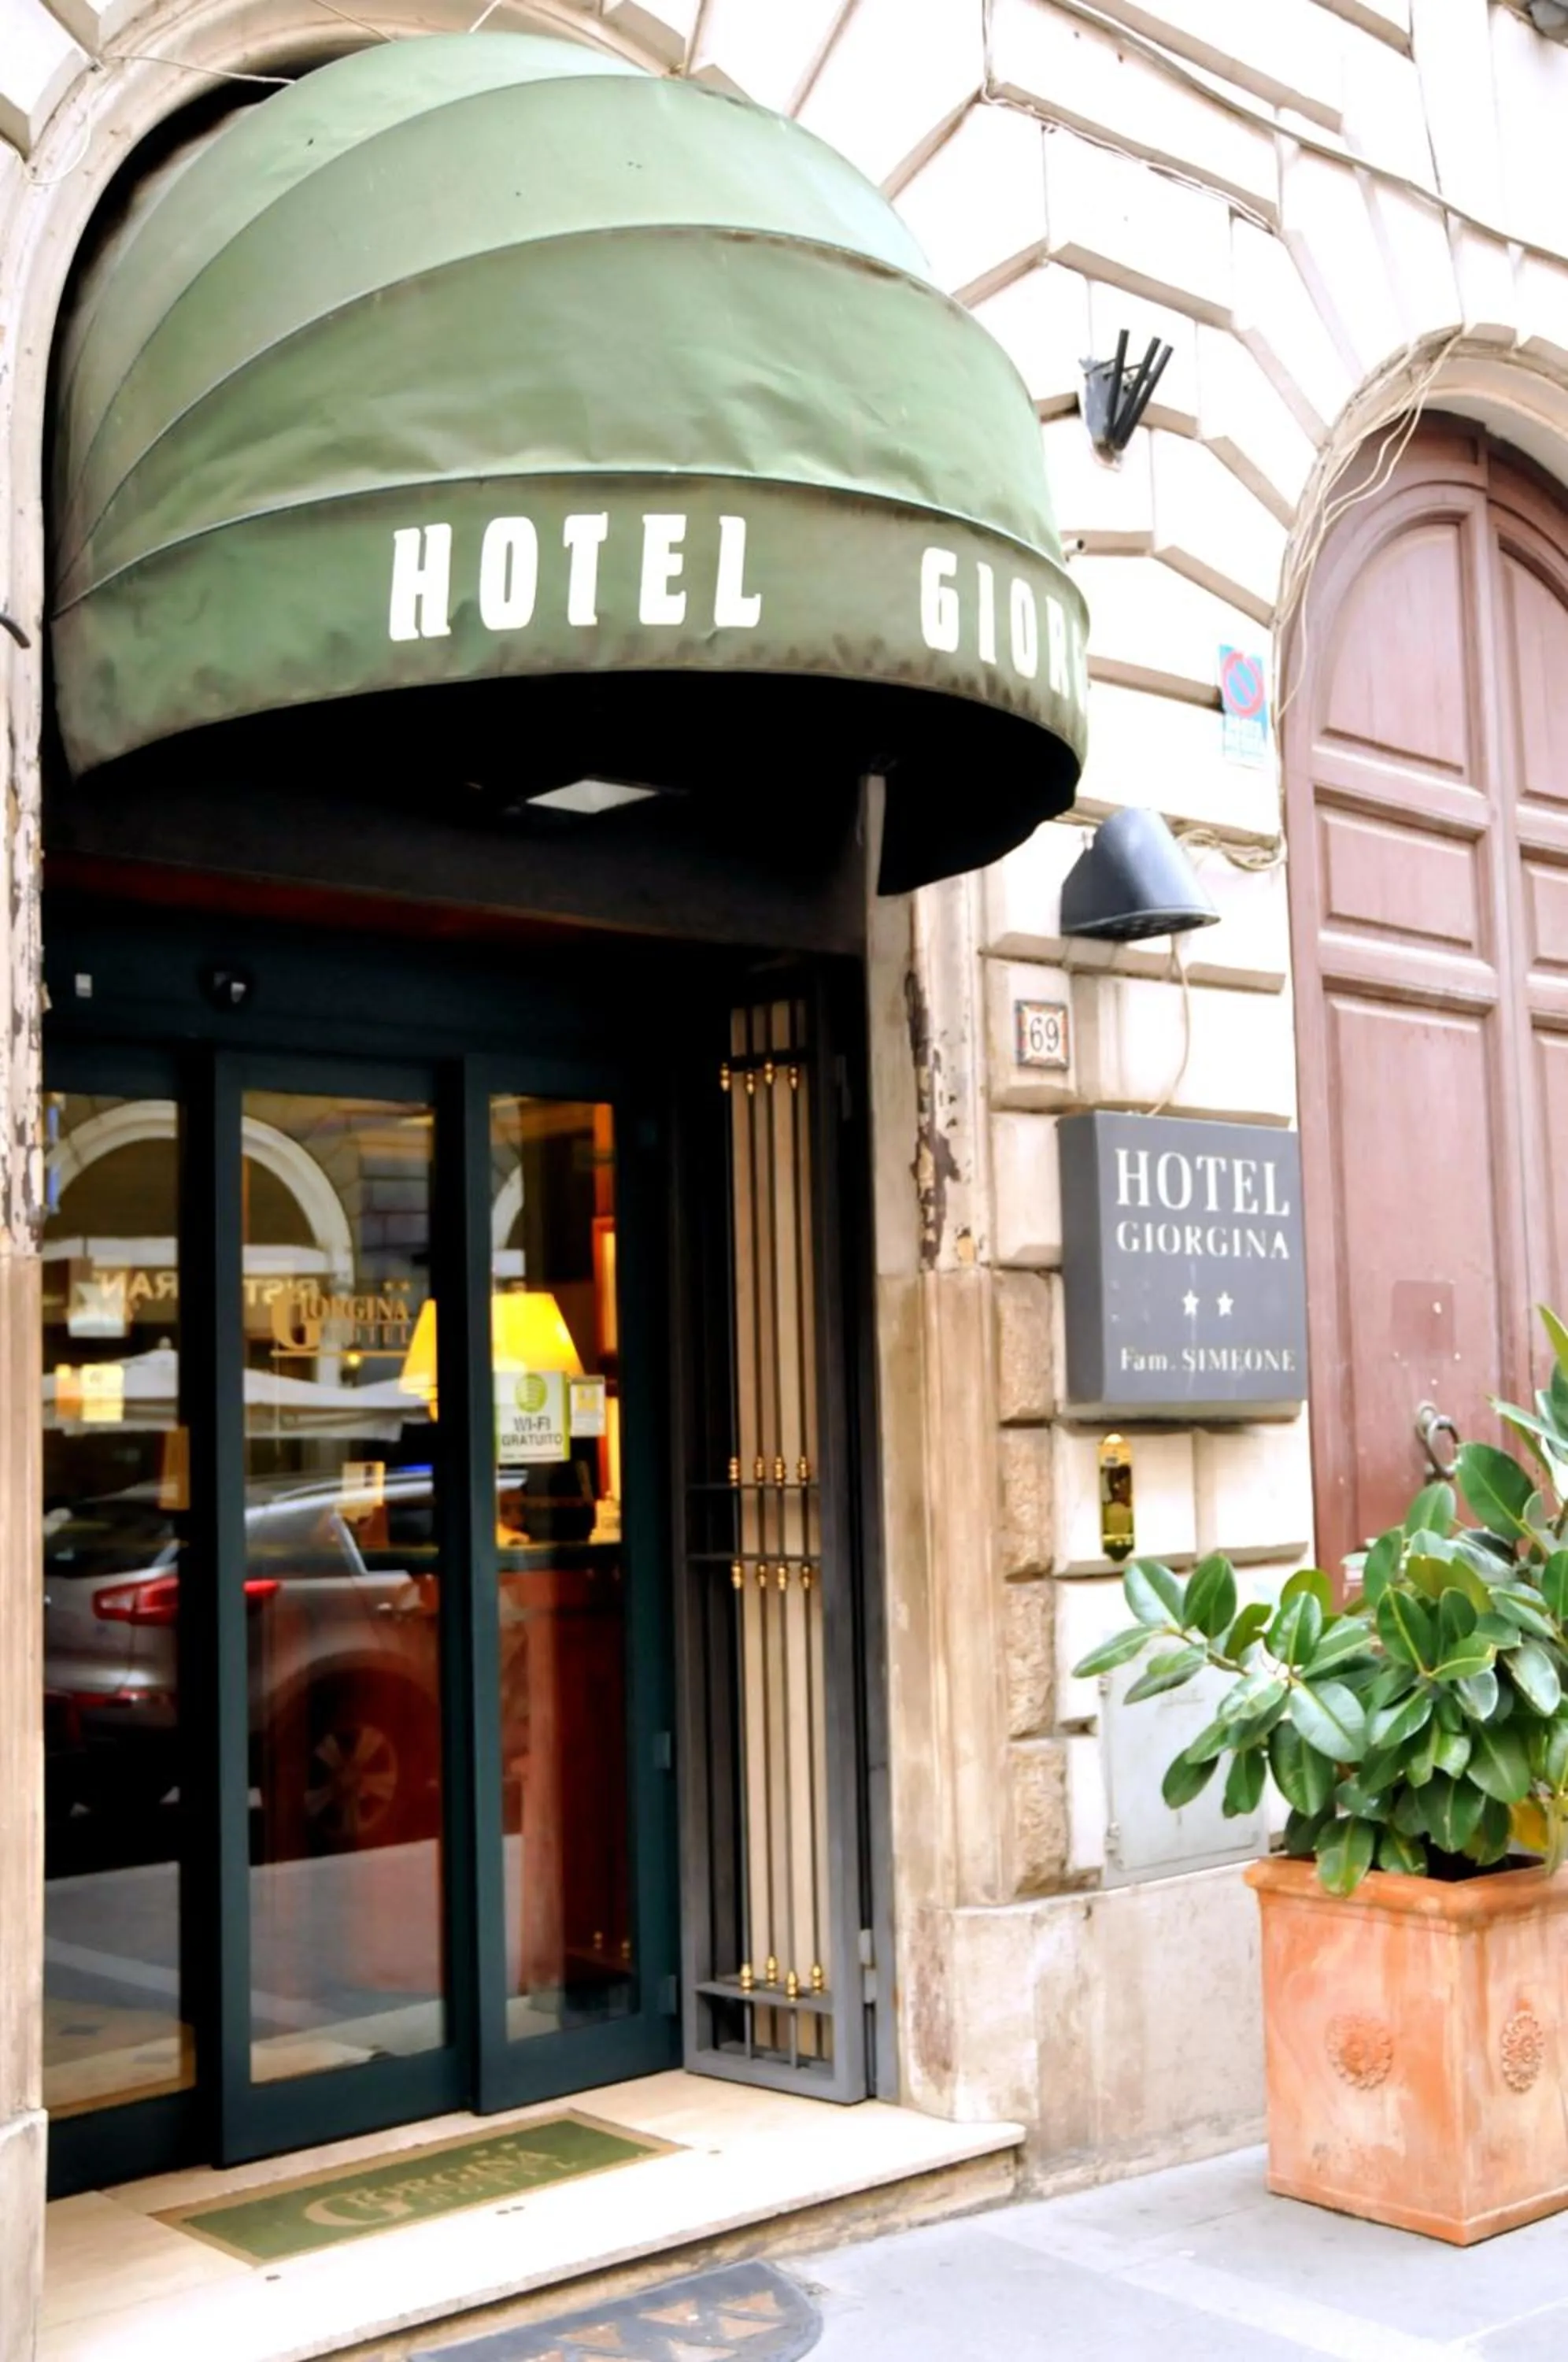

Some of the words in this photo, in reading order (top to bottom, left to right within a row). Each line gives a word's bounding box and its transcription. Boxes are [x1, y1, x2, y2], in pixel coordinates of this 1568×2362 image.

[390, 512, 761, 641] HOTEL
[1030, 1016, 1060, 1053] 69
[1115, 1148, 1290, 1216] HOTEL
[1116, 1220, 1289, 1260] GIORGINA
[1182, 1347, 1296, 1373] SIMEONE
[501, 1434, 563, 1447] GRATUITO
[513, 1416, 551, 1431] WI-FI
